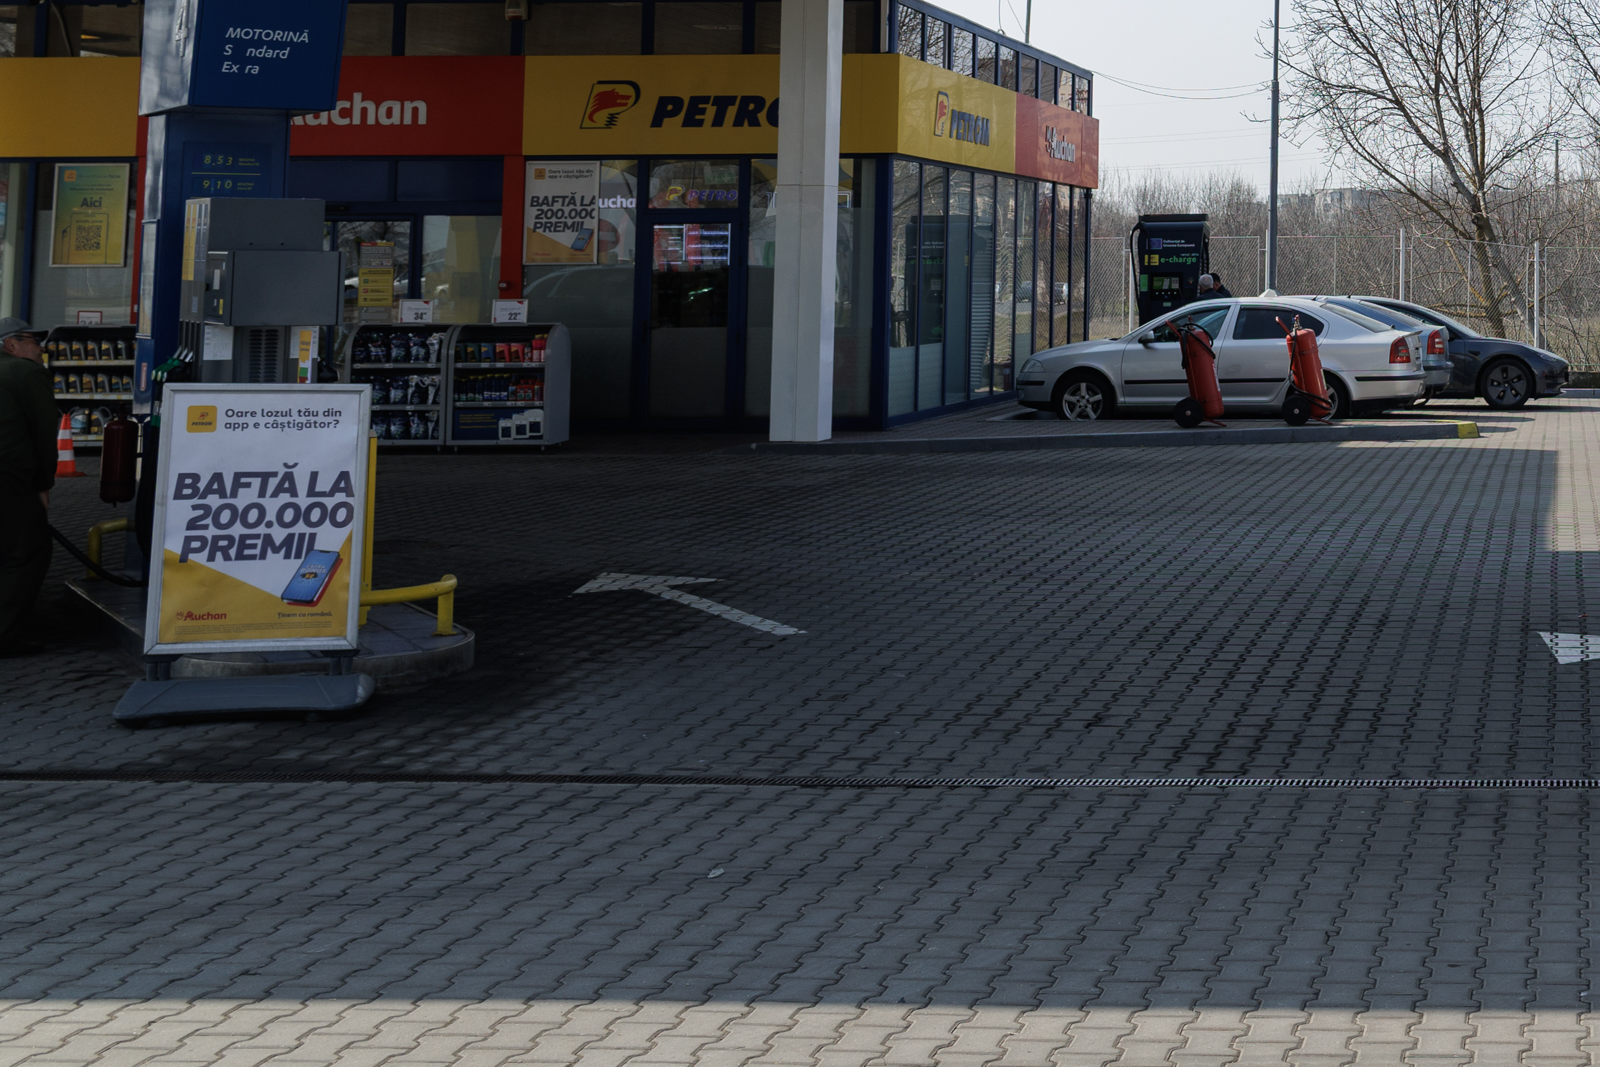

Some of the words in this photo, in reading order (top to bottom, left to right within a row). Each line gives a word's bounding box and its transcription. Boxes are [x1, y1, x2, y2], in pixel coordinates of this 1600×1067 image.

[225, 27, 309, 44] MOTORINĂ
[221, 62, 260, 75] Exra
[650, 95, 779, 128] PETR
[949, 108, 990, 147] PETROM
[204, 155, 233, 166] 8.53
[203, 180, 232, 191] 9.10
[81, 197, 102, 207] Aici
[530, 192, 577, 207] BAFTĂ
[580, 196, 596, 207] LA
[688, 190, 738, 202] PETRO
[1160, 255, 1197, 265] e-charge
[225, 408, 257, 418] Oare
[261, 408, 293, 418] lozul
[297, 408, 319, 418] tău
[322, 408, 342, 417] din
[224, 421, 249, 431] app
[253, 421, 260, 429] e
[264, 419, 340, 432] câștigător?
[173, 462, 299, 501] BAFTĂ
[305, 470, 355, 498] LA
[185, 501, 355, 532] 200.000
[184, 610, 227, 621] Auchan
